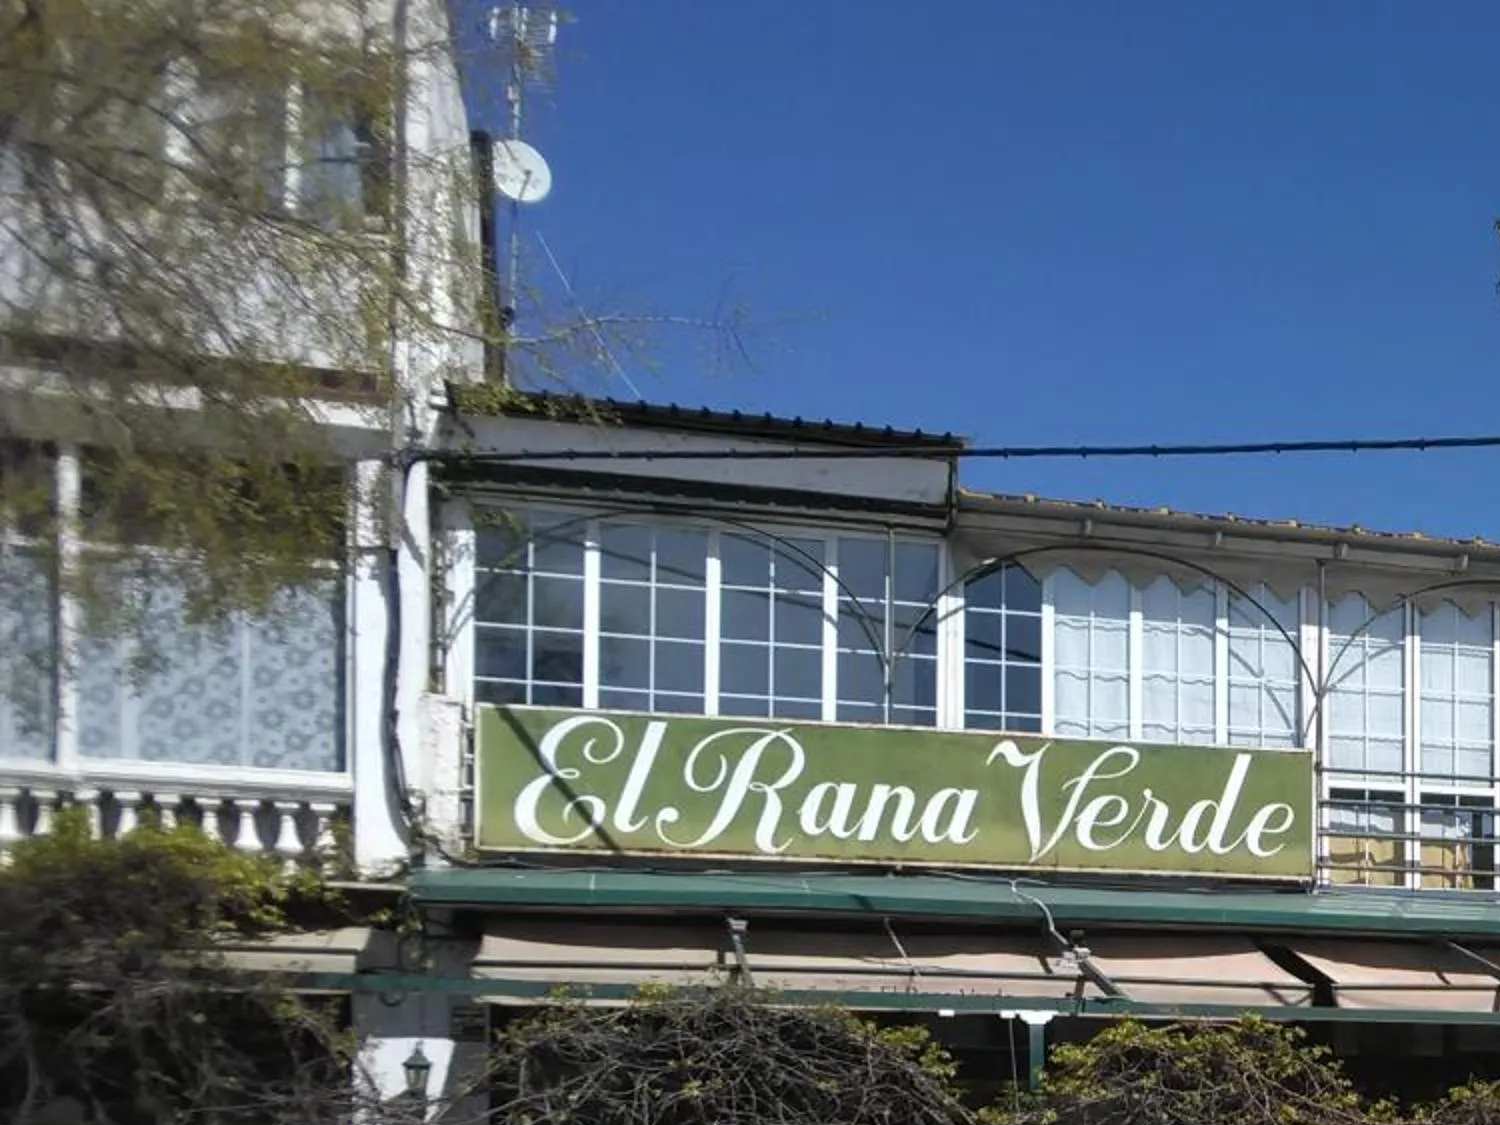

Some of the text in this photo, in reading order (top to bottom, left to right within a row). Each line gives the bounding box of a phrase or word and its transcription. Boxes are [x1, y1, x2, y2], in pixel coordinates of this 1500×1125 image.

[513, 716, 1294, 863] El Rana Verde
